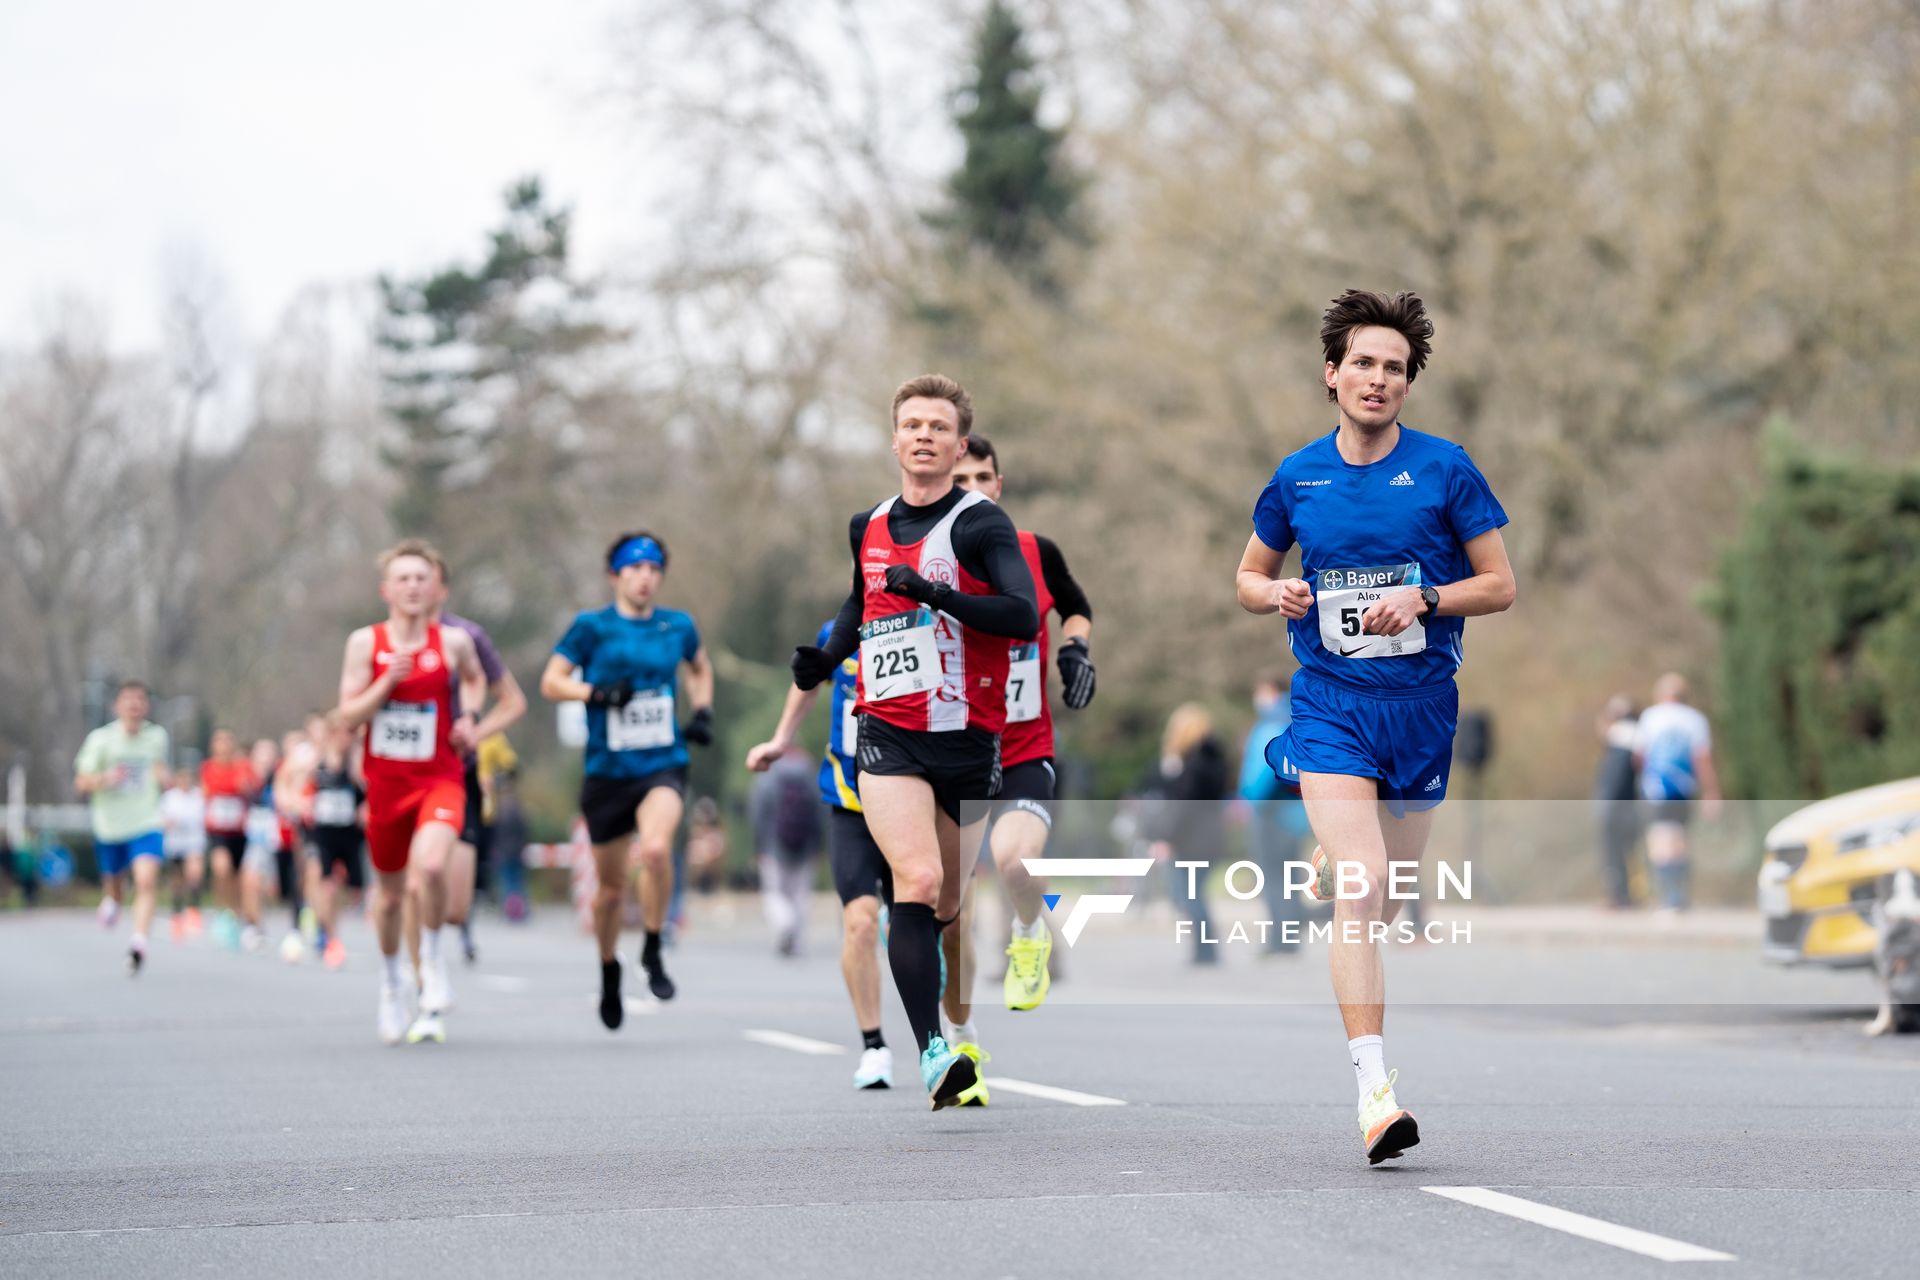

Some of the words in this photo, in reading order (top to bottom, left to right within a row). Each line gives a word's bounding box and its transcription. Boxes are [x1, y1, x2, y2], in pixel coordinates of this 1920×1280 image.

[1346, 570, 1394, 587] Bayer
[1357, 591, 1381, 601] Alex
[872, 616, 909, 635] Bayer
[877, 634, 905, 647] Lothar
[873, 646, 920, 680] 225
